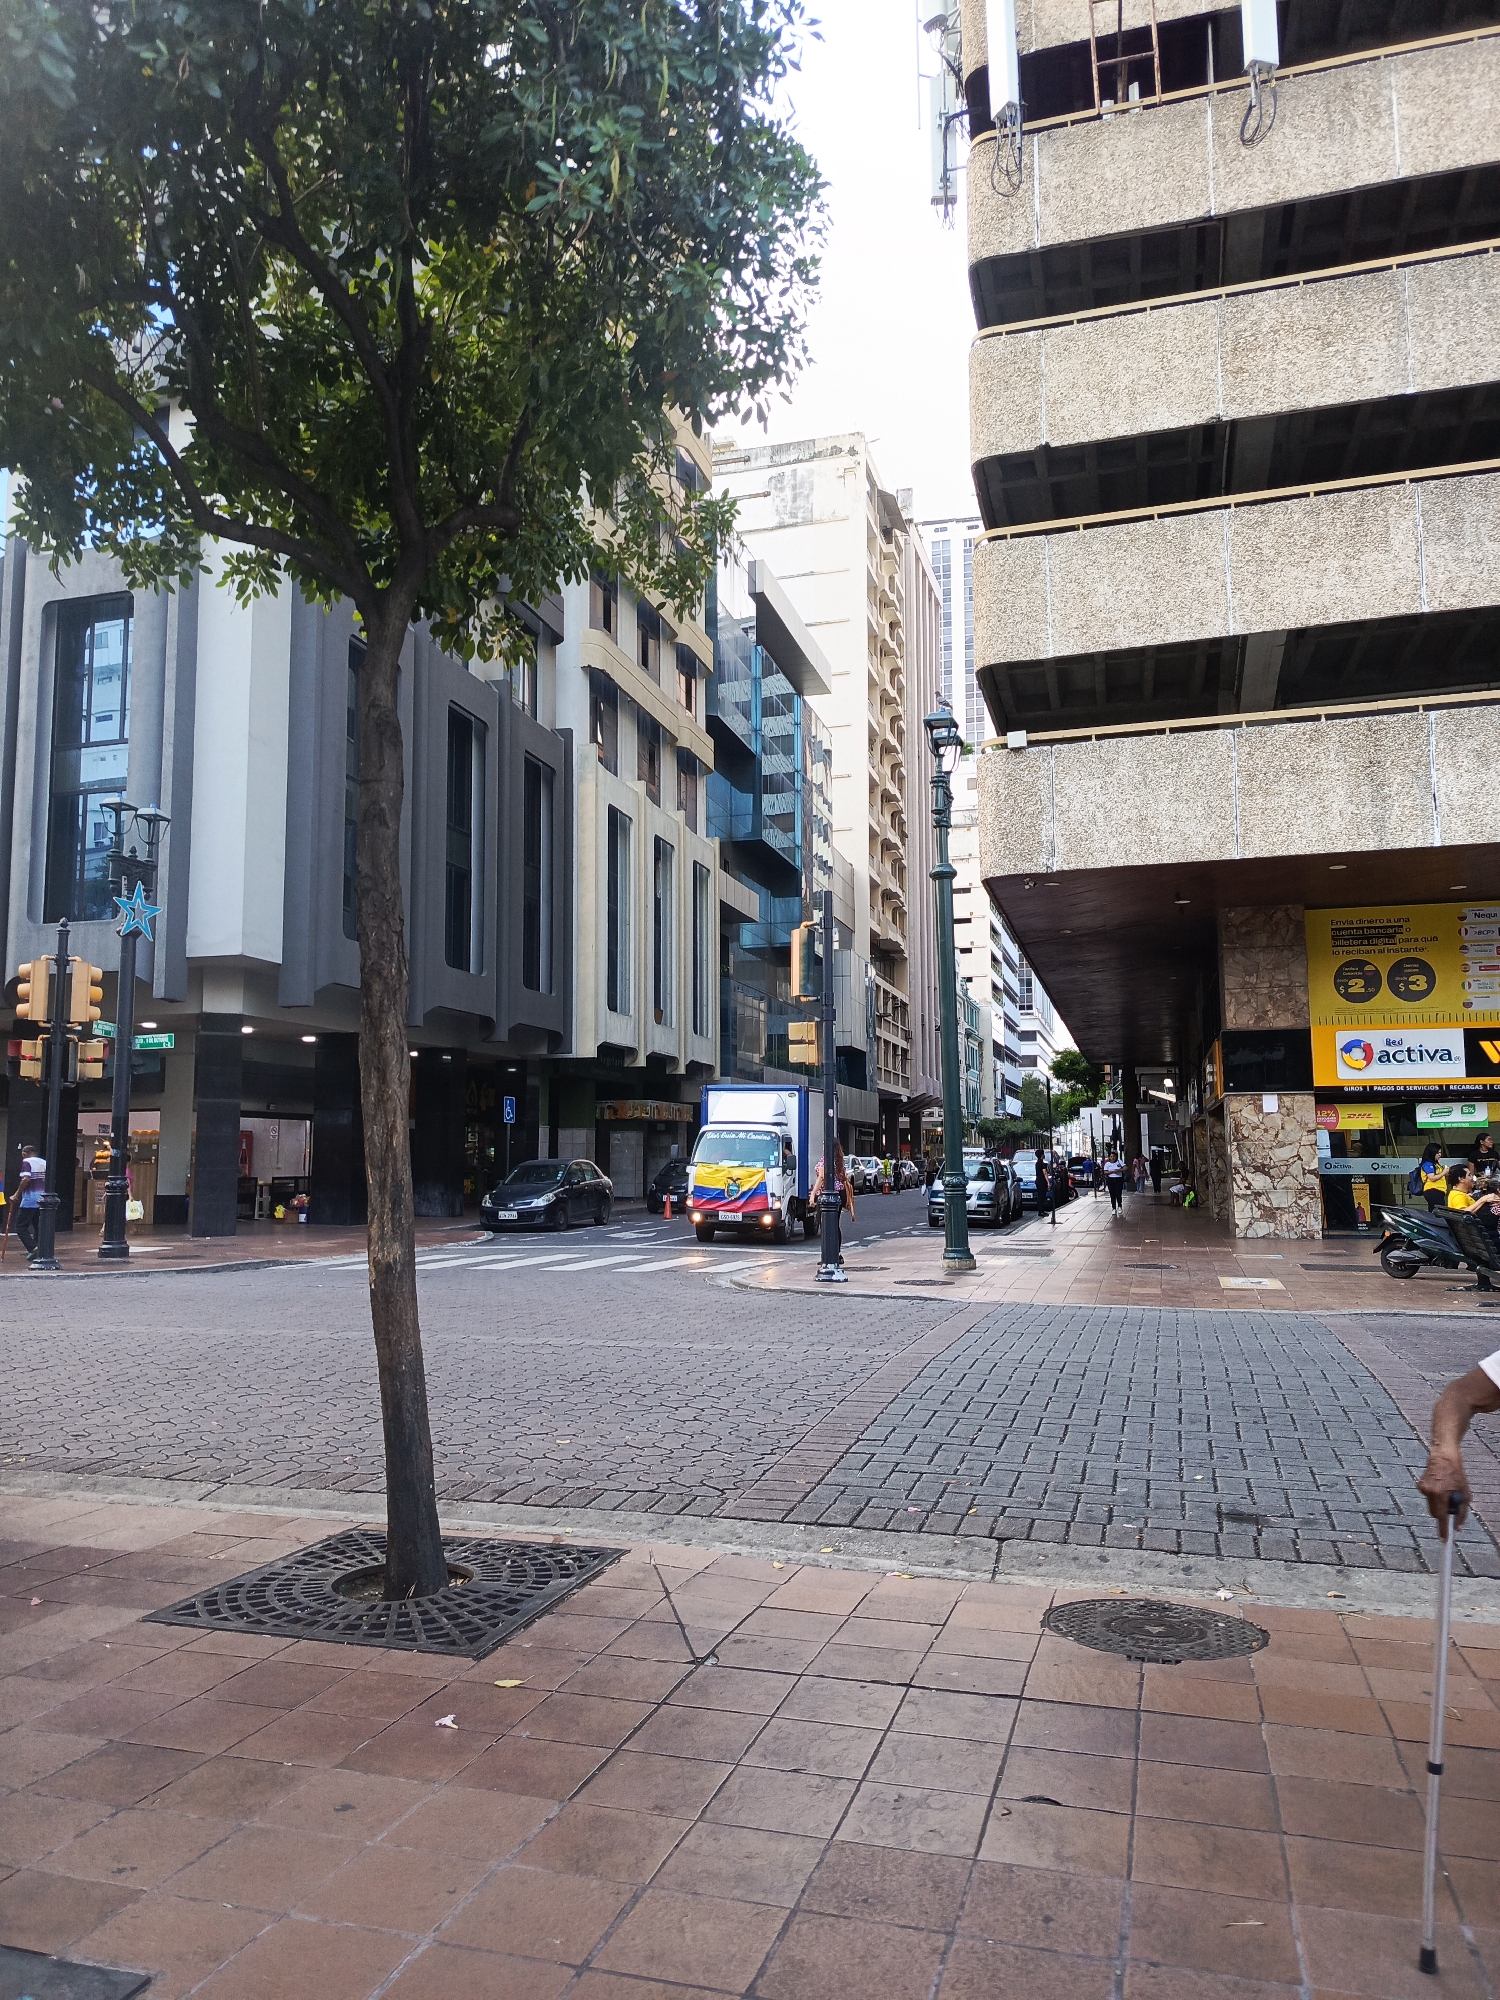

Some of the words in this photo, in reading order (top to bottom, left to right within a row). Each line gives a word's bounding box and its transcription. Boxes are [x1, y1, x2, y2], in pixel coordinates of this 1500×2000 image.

[1356, 917, 1384, 925] dinero
[1331, 928, 1363, 936] cuenta
[1364, 926, 1403, 934] bancaria
[1332, 938, 1368, 946] billetera
[1370, 937, 1397, 946] digital
[1398, 936, 1419, 944] para
[1421, 935, 1439, 943] que
[1342, 947, 1375, 955] reciban
[1408, 975, 1428, 991] 3
[1385, 1038, 1403, 1046] Red
[1377, 1044, 1453, 1064] activa
